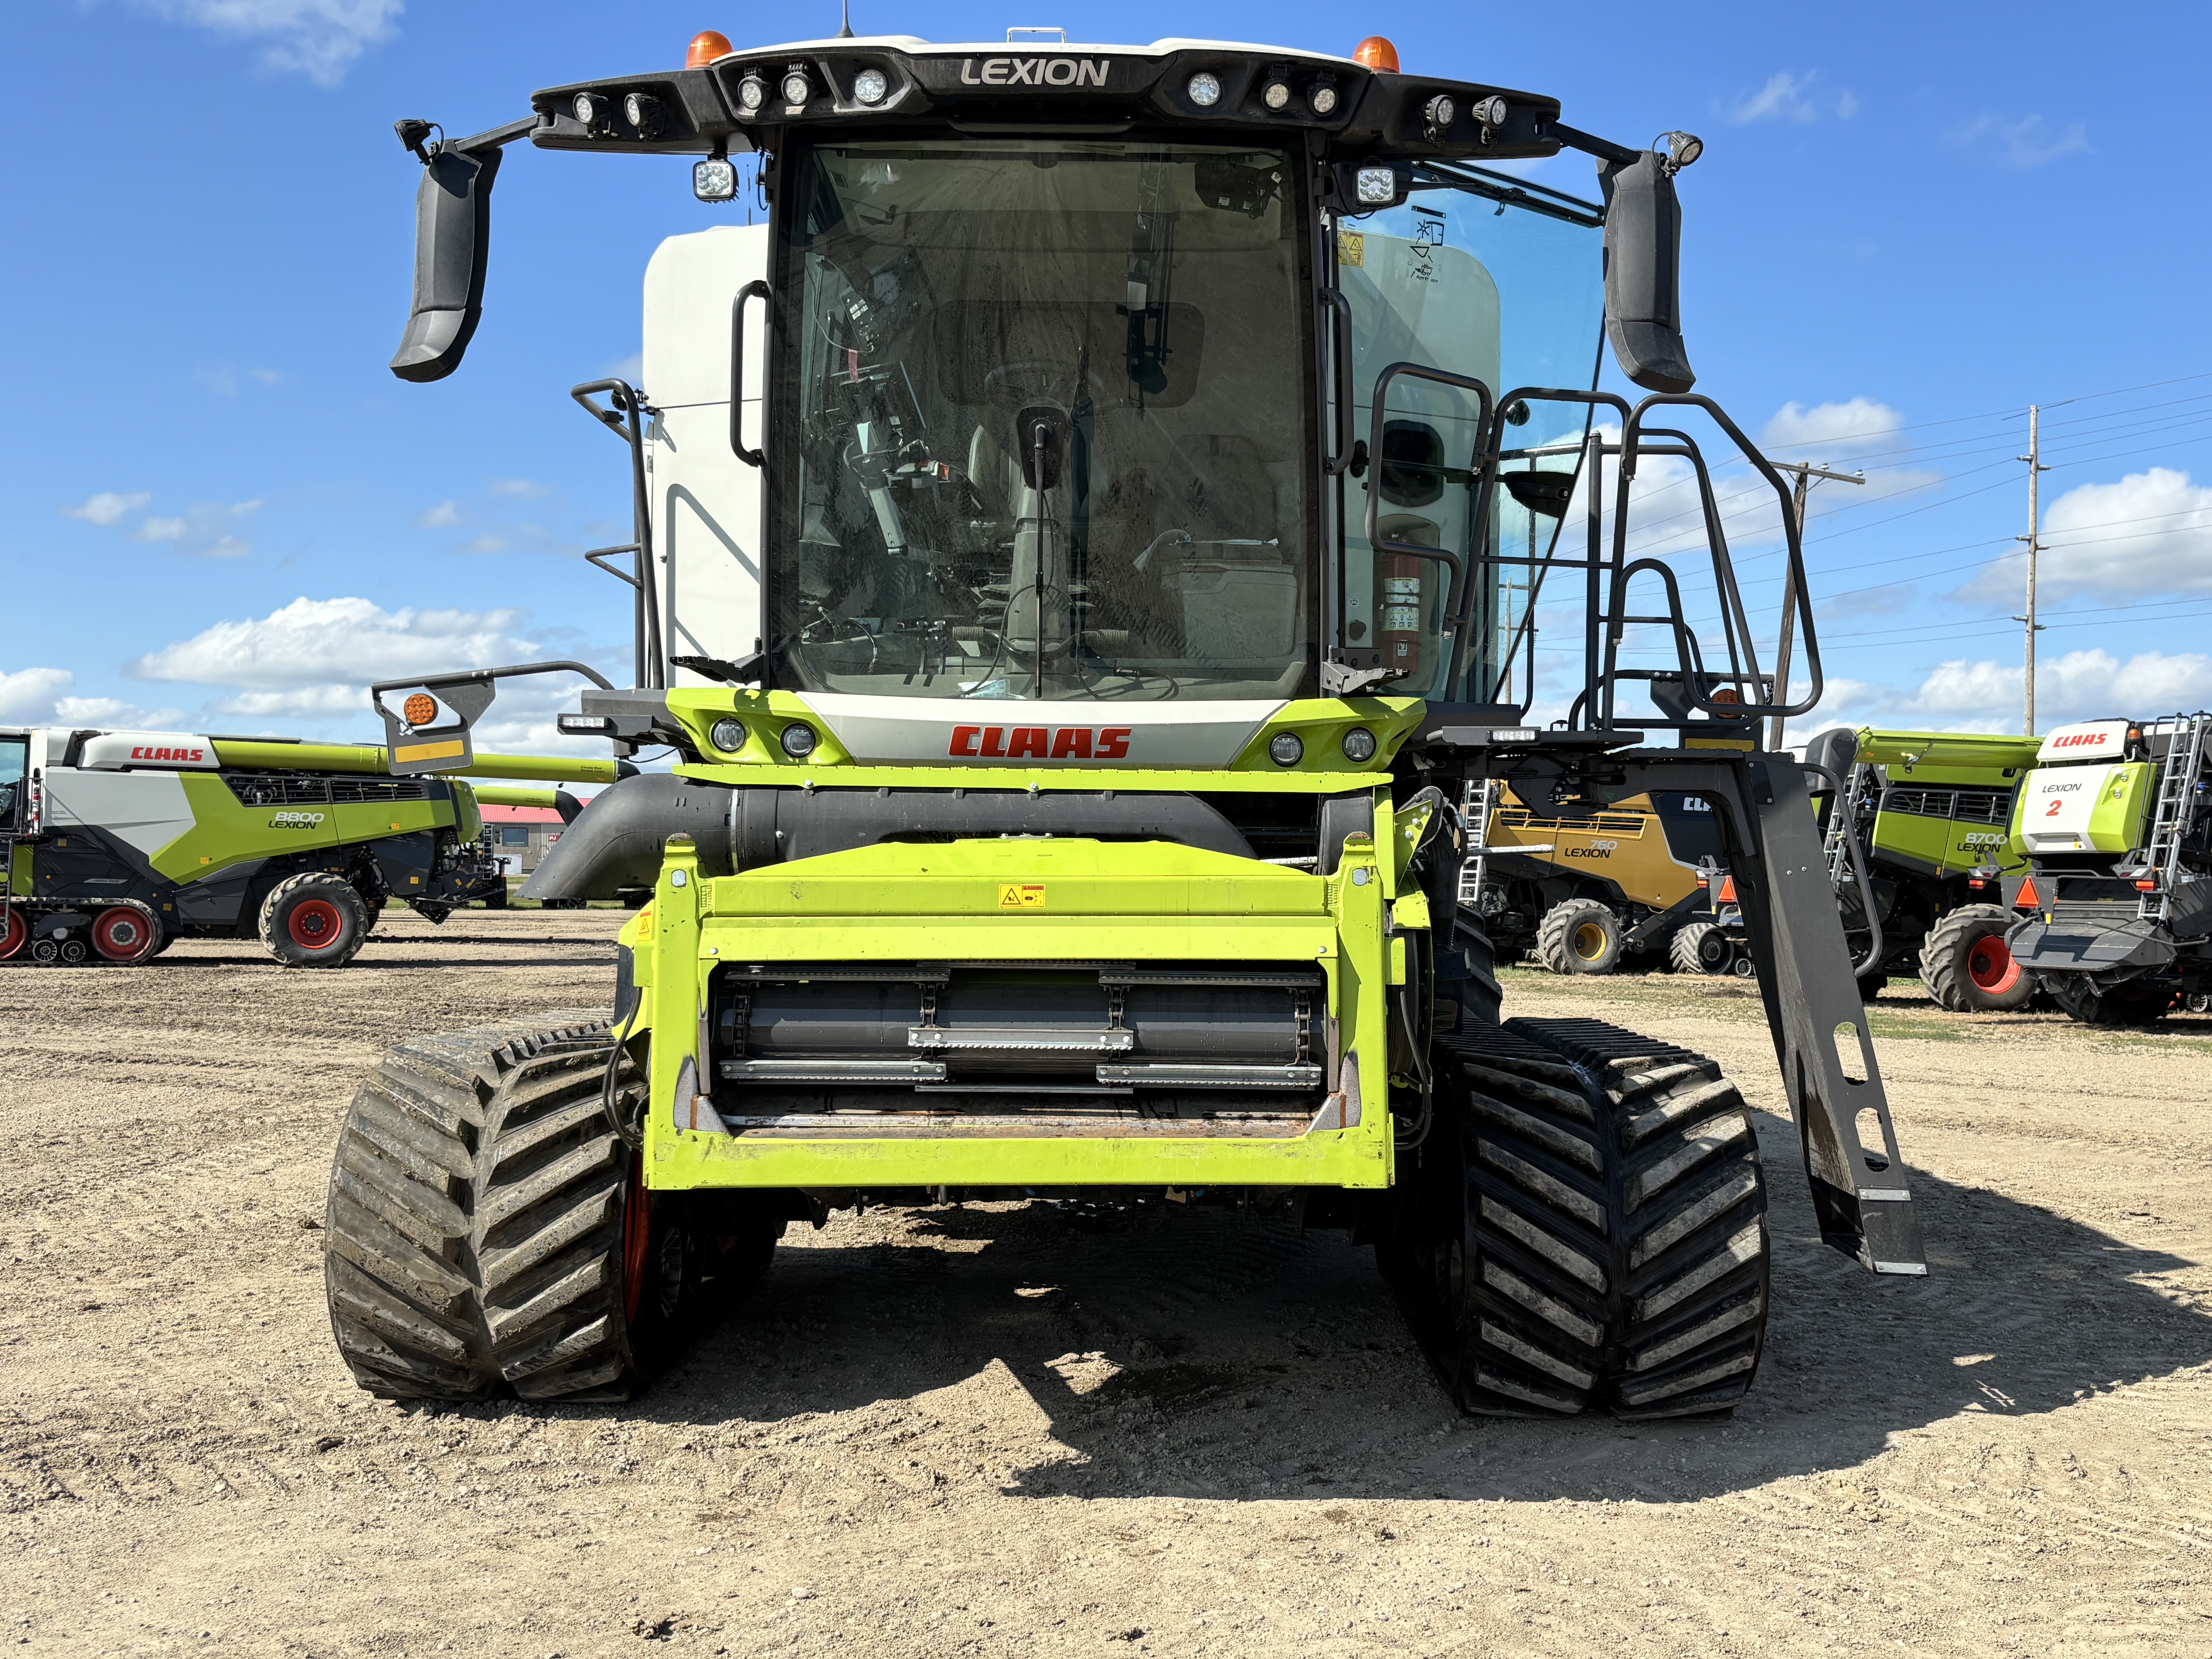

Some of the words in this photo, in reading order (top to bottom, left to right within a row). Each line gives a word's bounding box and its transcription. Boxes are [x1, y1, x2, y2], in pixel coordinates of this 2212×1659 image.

[961, 58, 1110, 86] LEXION
[949, 725, 1132, 758] CLAAS
[2053, 733, 2107, 747] CLAAS
[131, 747, 204, 761] CLAAS
[2042, 783, 2082, 793] LEXION
[2046, 800, 2062, 816] 2
[275, 812, 325, 822] 8800
[268, 820, 317, 829] LEXION
[1965, 833, 2008, 844] 8700
[1589, 840, 1618, 850] 760
[1957, 842, 2001, 853] LEXION
[1565, 848, 1611, 858] LEXION
